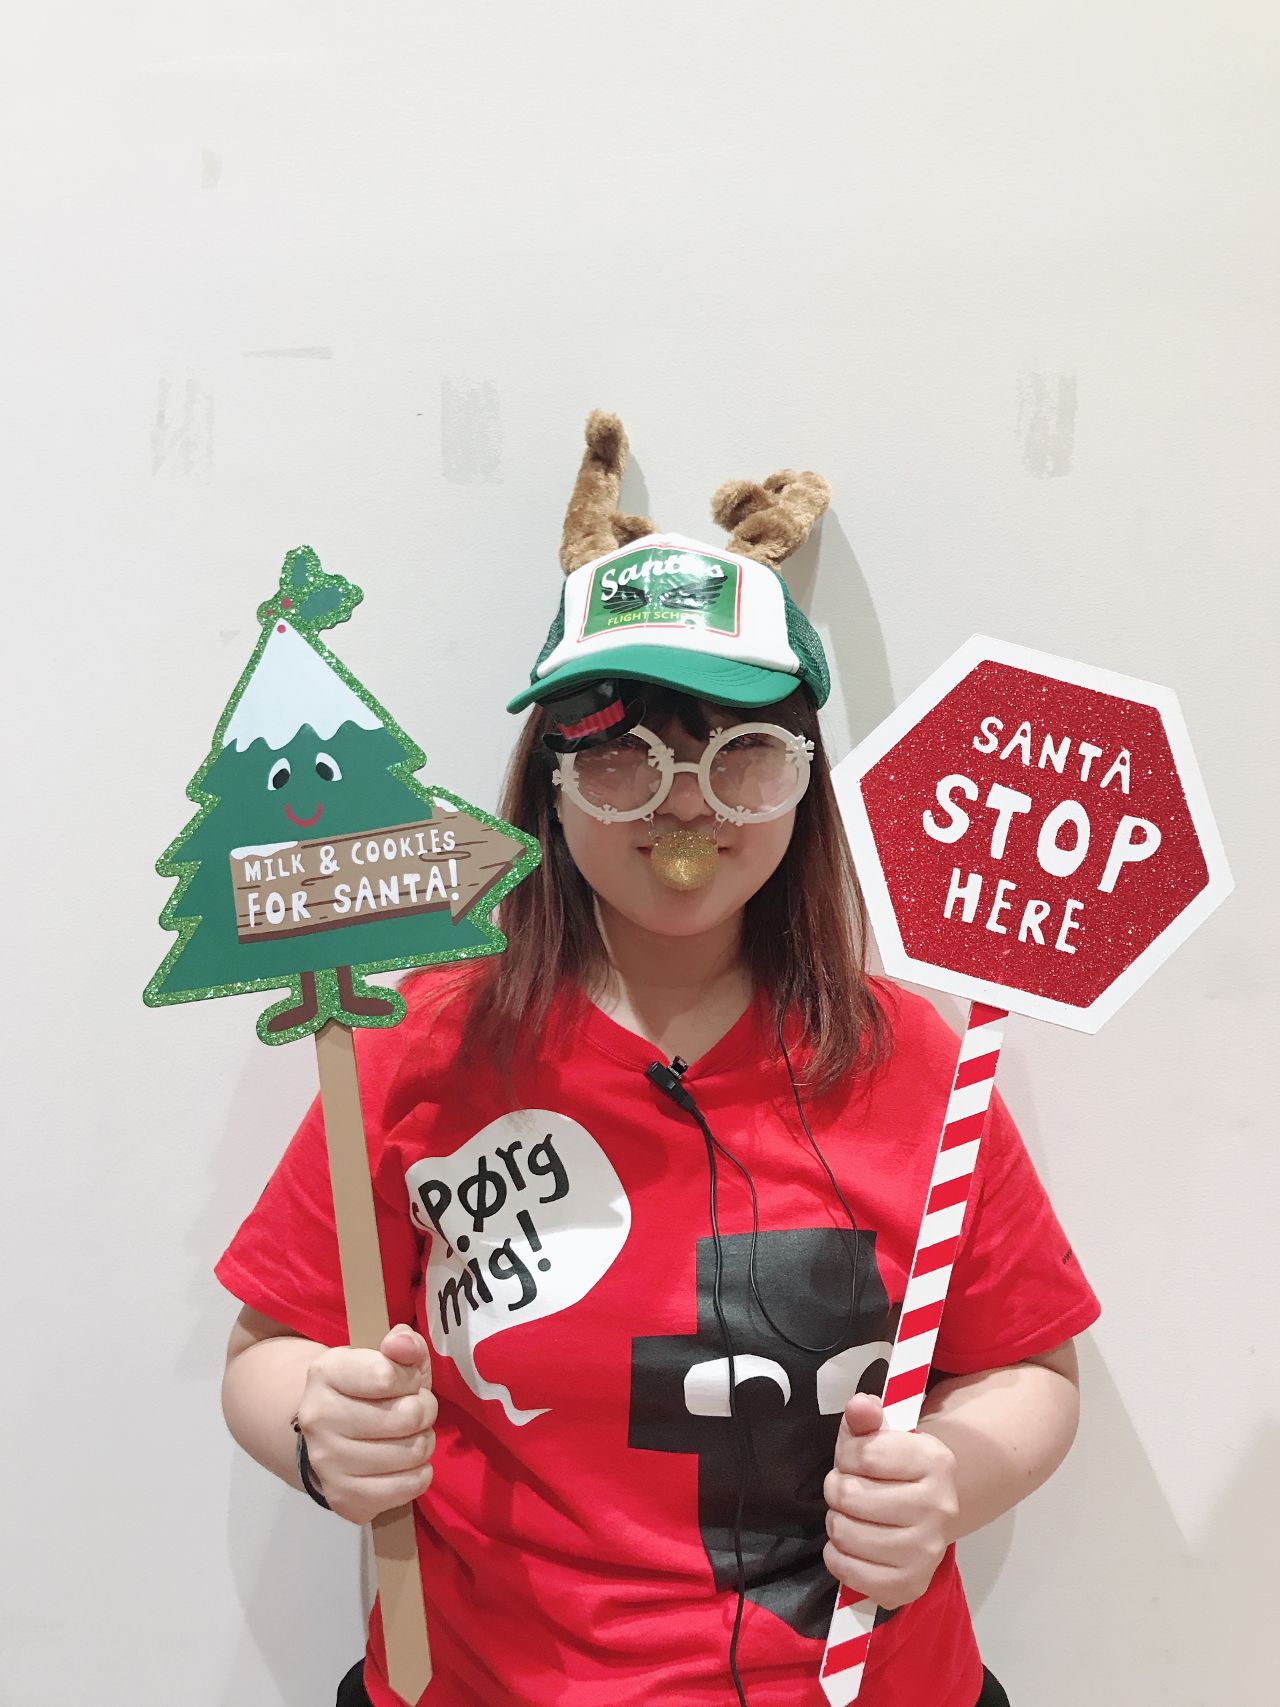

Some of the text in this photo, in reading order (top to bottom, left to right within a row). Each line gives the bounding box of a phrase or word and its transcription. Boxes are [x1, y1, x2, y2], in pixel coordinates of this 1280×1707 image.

[607, 611, 649, 626] FLIGHT
[972, 716, 1131, 795] SANTA
[244, 829, 457, 883] MILK & COOKIES
[922, 773, 1162, 893] STOP
[247, 858, 461, 928] FOR SANTA!
[943, 867, 1085, 955] HERE
[437, 1209, 552, 1335] mig!
